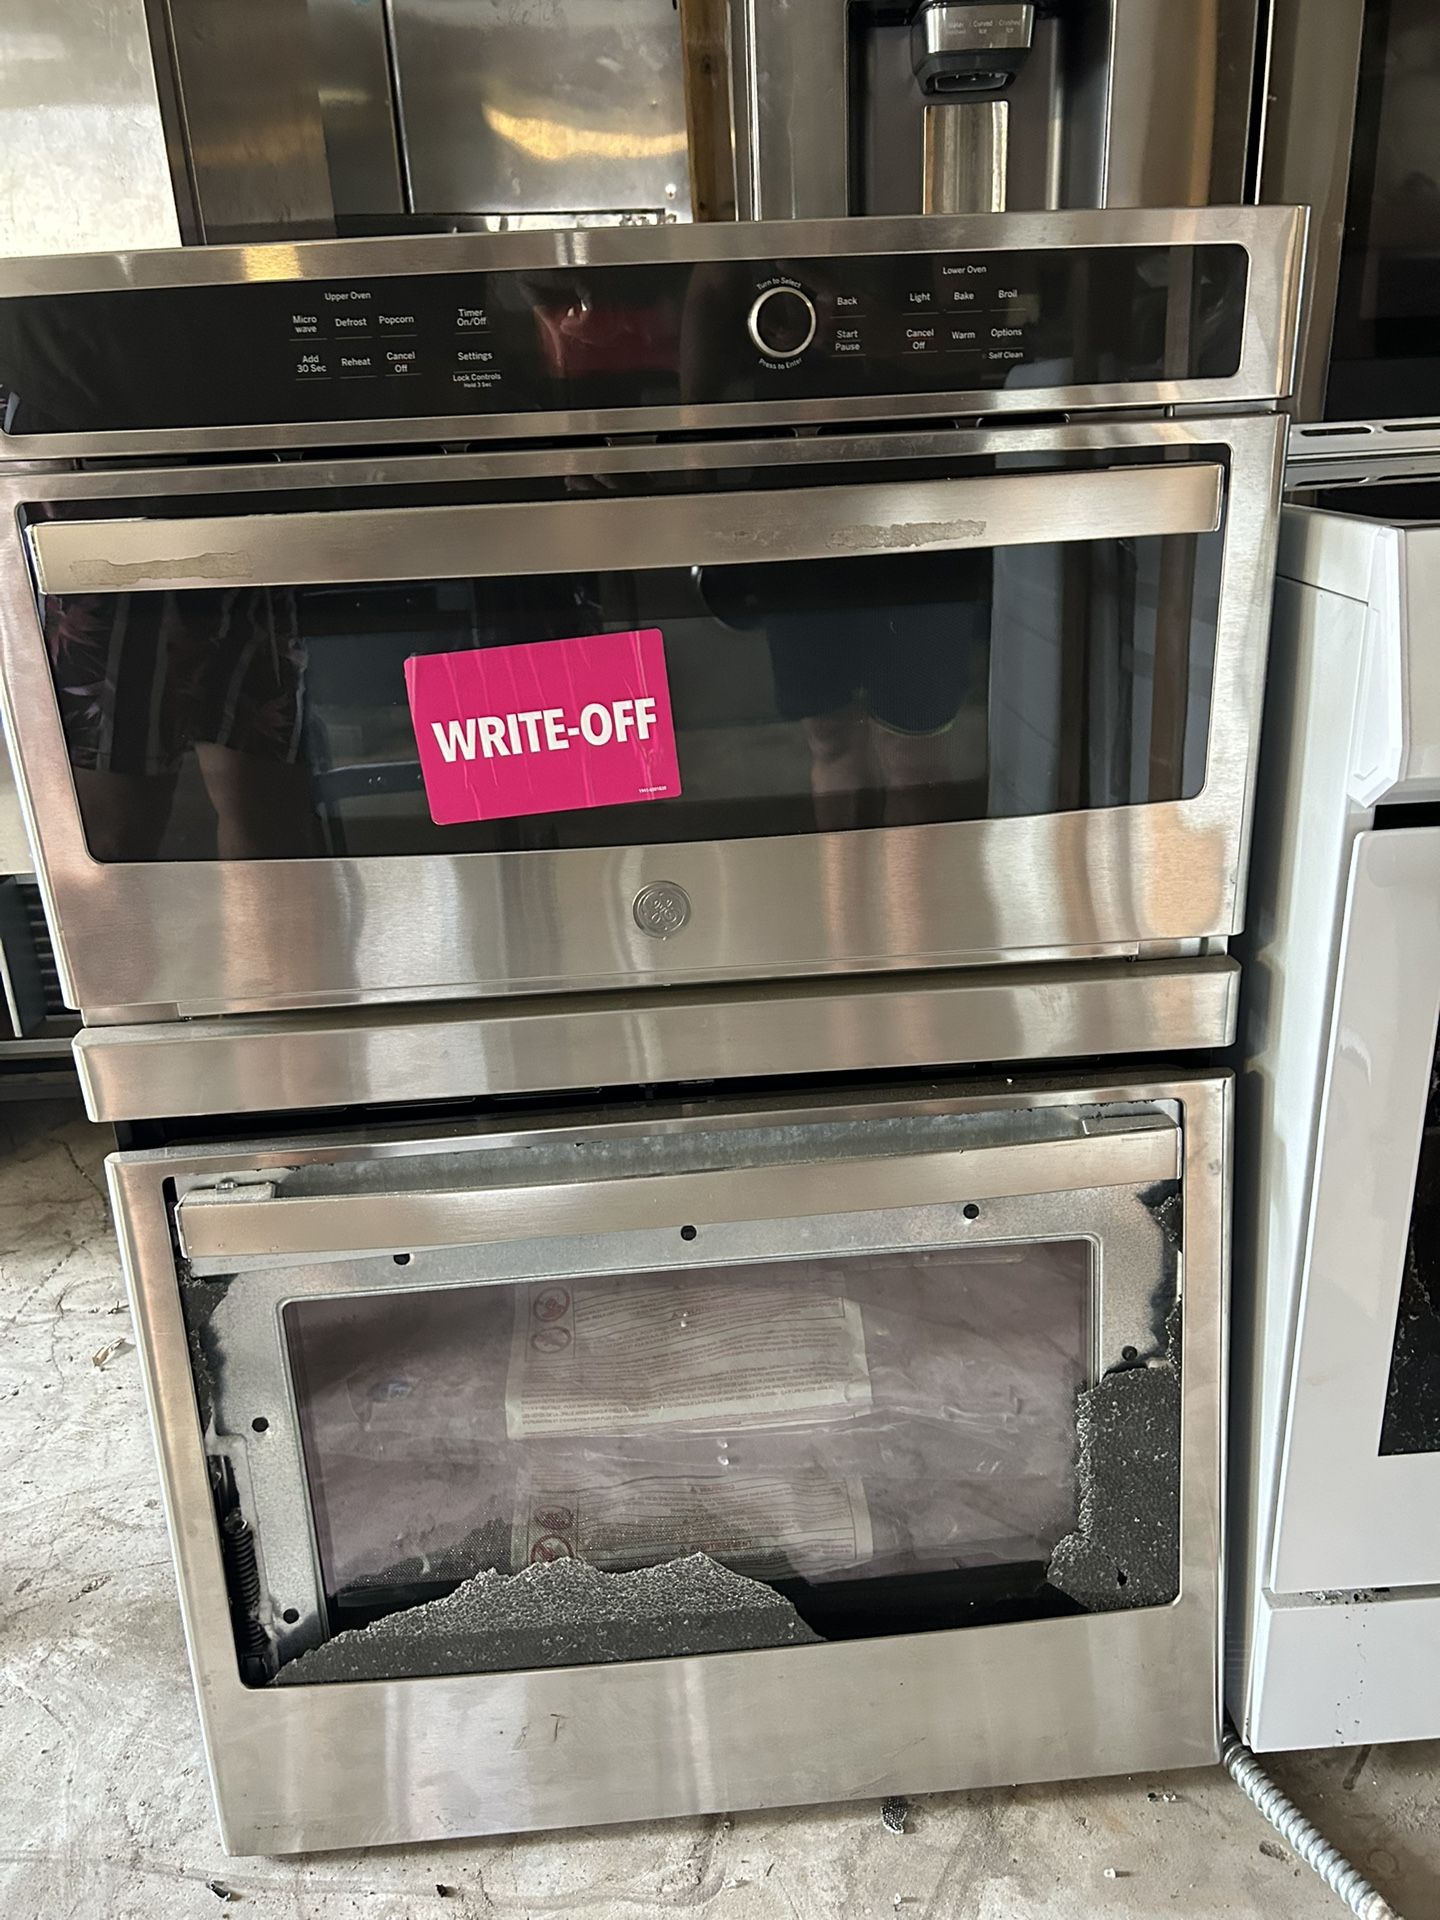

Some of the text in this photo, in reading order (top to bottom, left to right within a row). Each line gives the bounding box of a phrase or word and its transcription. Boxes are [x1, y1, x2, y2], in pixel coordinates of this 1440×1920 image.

[756, 280, 771, 289] Turn
[781, 276, 801, 288] Select
[325, 291, 371, 302] Upper Oven
[910, 290, 1017, 303] Light Bake Broil
[837, 297, 857, 305] Back
[293, 315, 317, 323] Micro
[335, 318, 367, 326] Defrost
[379, 316, 414, 325] Popcorn
[457, 317, 486, 326] On/Off
[837, 330, 858, 338] Start
[906, 329, 934, 337] Cancel
[991, 328, 1022, 338] Options
[835, 343, 860, 351] Pause
[913, 341, 925, 349] Off
[302, 355, 319, 363] Add
[387, 352, 415, 360] Cancel
[458, 352, 492, 361] Settings
[341, 358, 371, 366] Reheat
[297, 364, 326, 372] 30 Sec
[471, 373, 501, 381] Controls
[431, 697, 657, 762] WRITE-OFF
